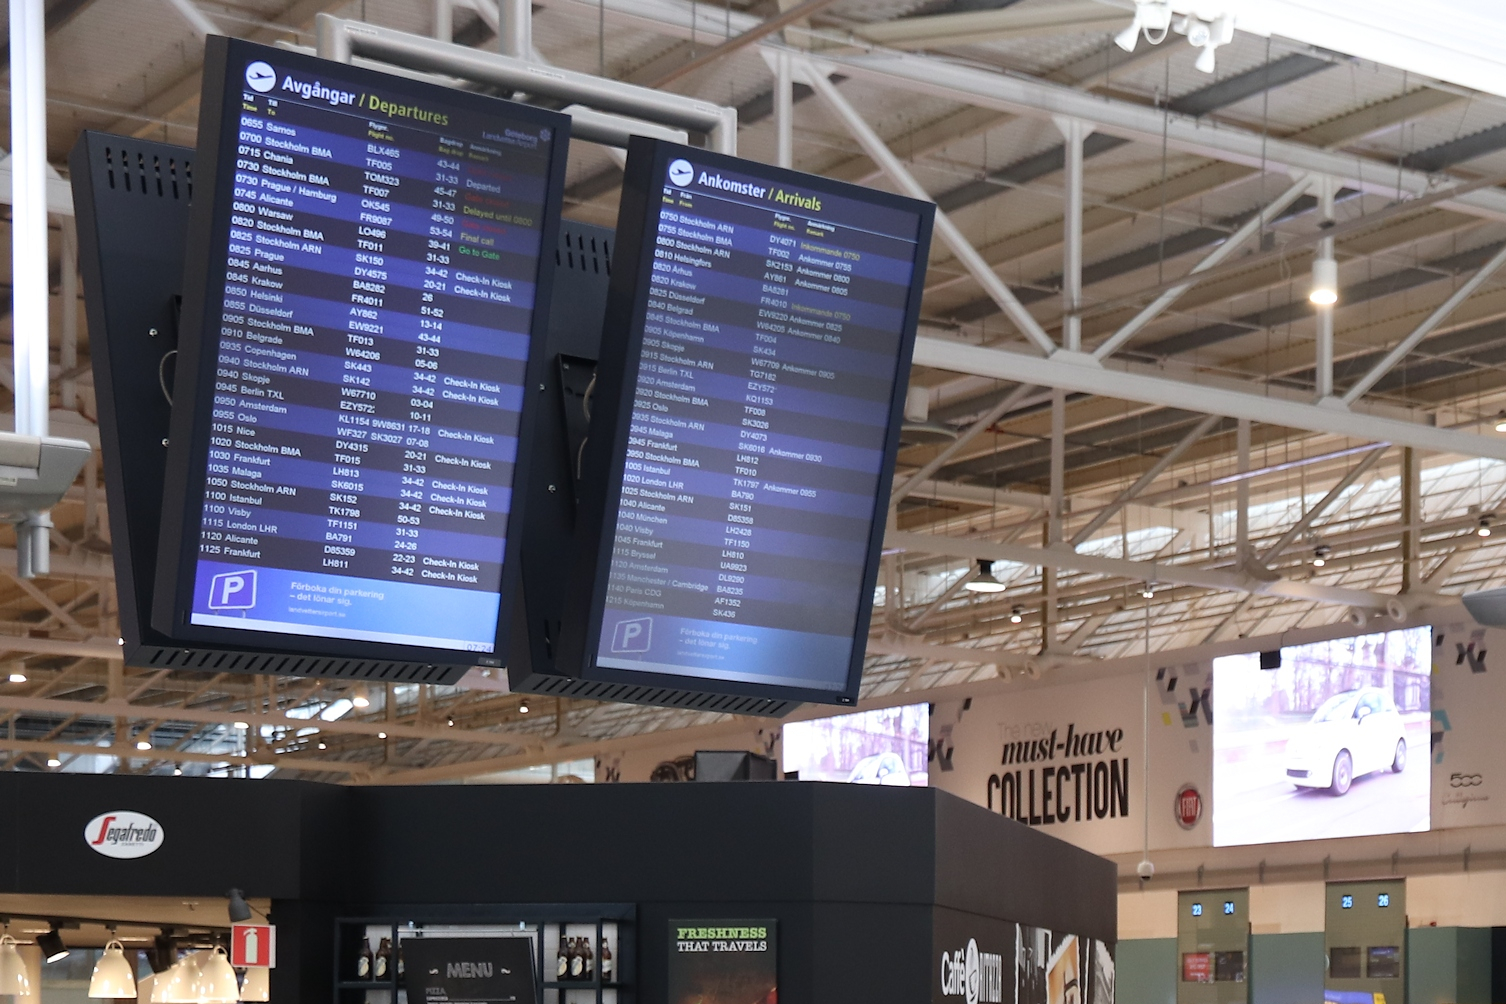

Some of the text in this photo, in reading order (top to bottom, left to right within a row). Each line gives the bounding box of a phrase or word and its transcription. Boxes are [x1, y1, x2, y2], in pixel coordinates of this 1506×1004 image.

[282, 74, 356, 106] Avgångar
[369, 95, 449, 127] Departures
[265, 136, 309, 154] Stockholm
[311, 146, 332, 159] BMA
[698, 171, 766, 199] Ankomster
[775, 188, 822, 212] Arrivals
[679, 215, 716, 230] Stockholm
[716, 224, 734, 234] ARN
[255, 234, 299, 250] Stockholm
[302, 242, 321, 254] ARN
[677, 228, 714, 243] Stockholm
[715, 236, 732, 247] BMA
[798, 254, 833, 268] Ankommer
[254, 248, 284, 264] Prague
[244, 344, 296, 363] Copenhagen
[641, 476, 667, 487] London
[668, 480, 684, 489] LHR
[643, 464, 670, 475] Istanbul
[763, 483, 798, 494] Ankommer
[226, 520, 257, 532] London
[259, 524, 277, 534] LHR
[223, 547, 260, 559] Frankfurt
[290, 582, 385, 601] Förboka din parkering
[296, 592, 311, 601] det
[1001, 723, 1123, 766] must-have
[1450, 773, 1483, 789] 500
[987, 758, 1129, 826] COLLECTION
[1182, 796, 1197, 817] FIAT
[91, 816, 157, 845] Segafredo
[1224, 902, 1234, 914] 24
[1342, 896, 1353, 908] 25
[1378, 894, 1389, 906] 26
[1192, 904, 1203, 916] 23
[677, 926, 767, 940] FRESHNESS
[677, 940, 768, 953] THAT TRAVELS
[446, 962, 494, 979] MENU
[941, 948, 965, 996] Caffè
